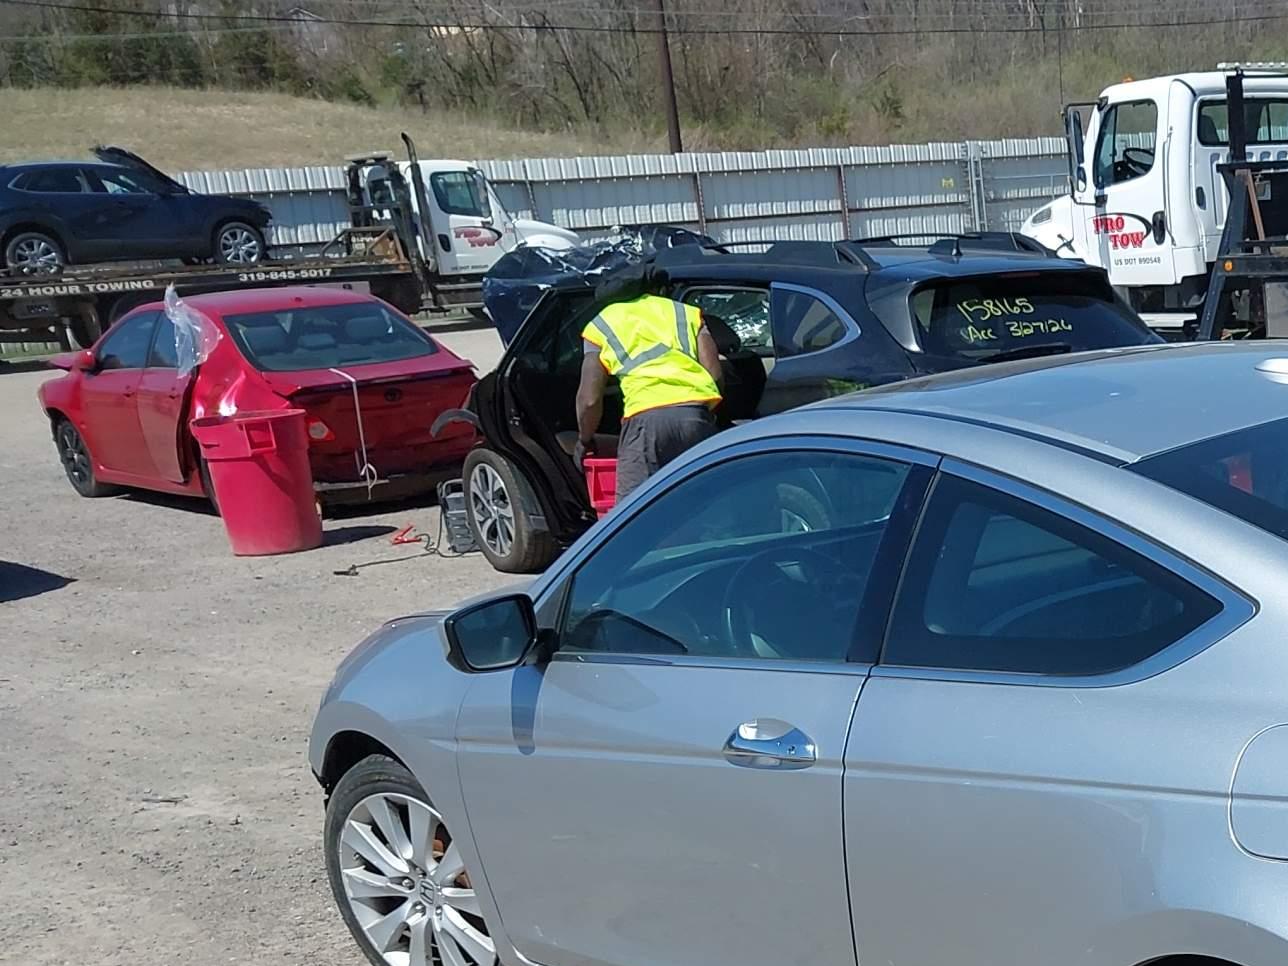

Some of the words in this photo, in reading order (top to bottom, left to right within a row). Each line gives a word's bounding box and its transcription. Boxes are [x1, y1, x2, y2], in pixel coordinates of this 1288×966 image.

[1093, 216, 1125, 234] PRO
[1110, 231, 1144, 250] TOW
[239, 268, 332, 282] 319-845-5017
[0, 288, 23, 297] 24
[28, 285, 80, 297] HOUR
[85, 279, 154, 293] TOWING
[957, 297, 1034, 323] 158165
